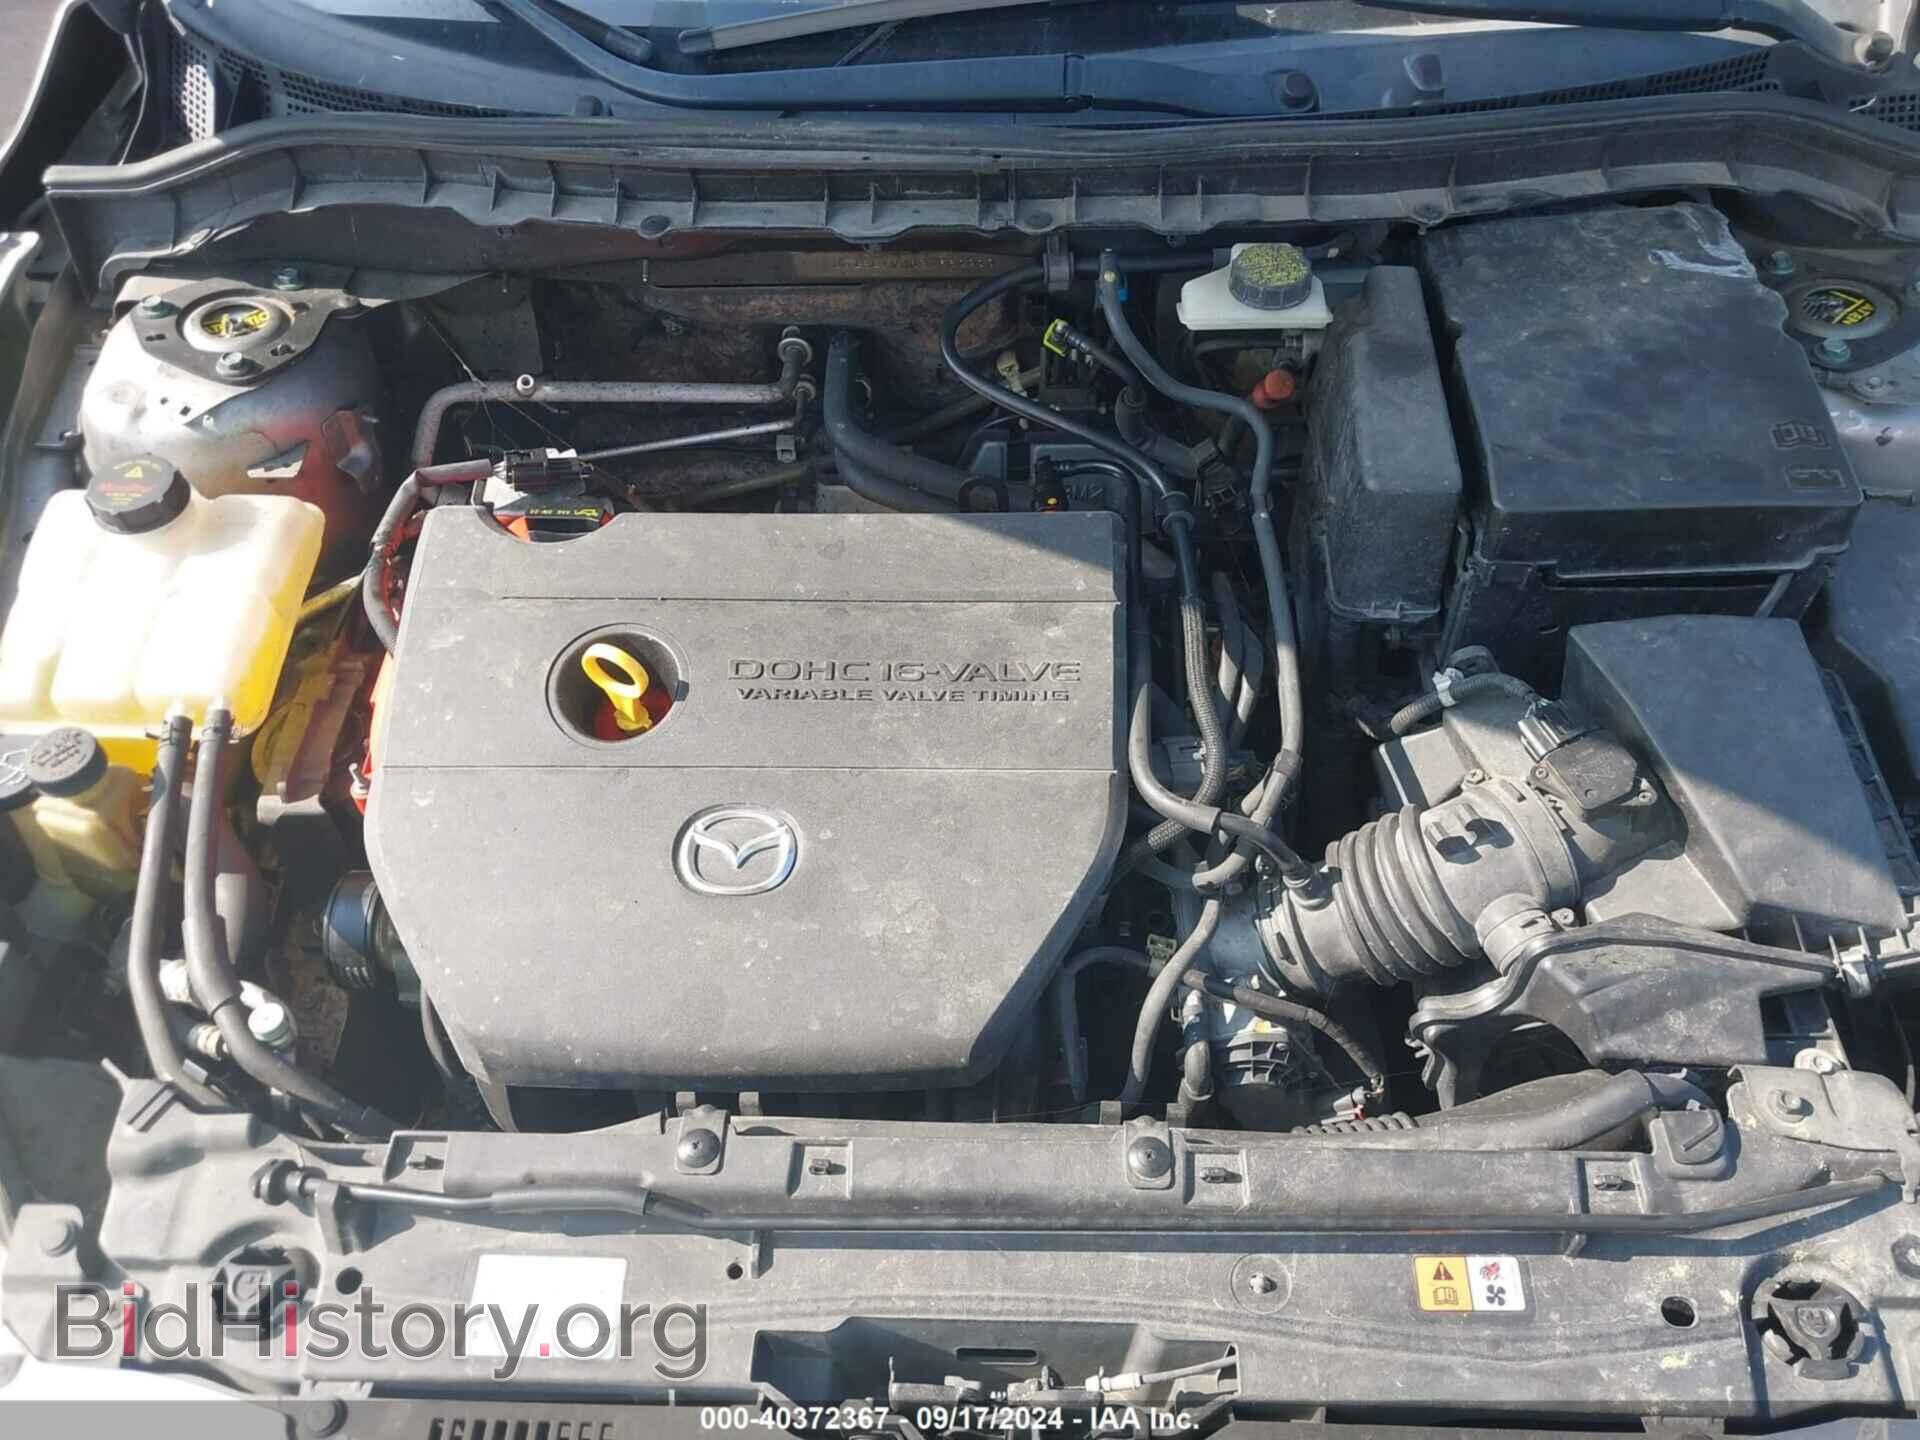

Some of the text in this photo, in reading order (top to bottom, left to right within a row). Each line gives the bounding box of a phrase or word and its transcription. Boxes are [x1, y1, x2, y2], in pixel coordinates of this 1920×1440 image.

[728, 659, 1083, 682] DOHC 16-VALVE
[737, 688, 1071, 702] VARIABLE VALVE TIMING
